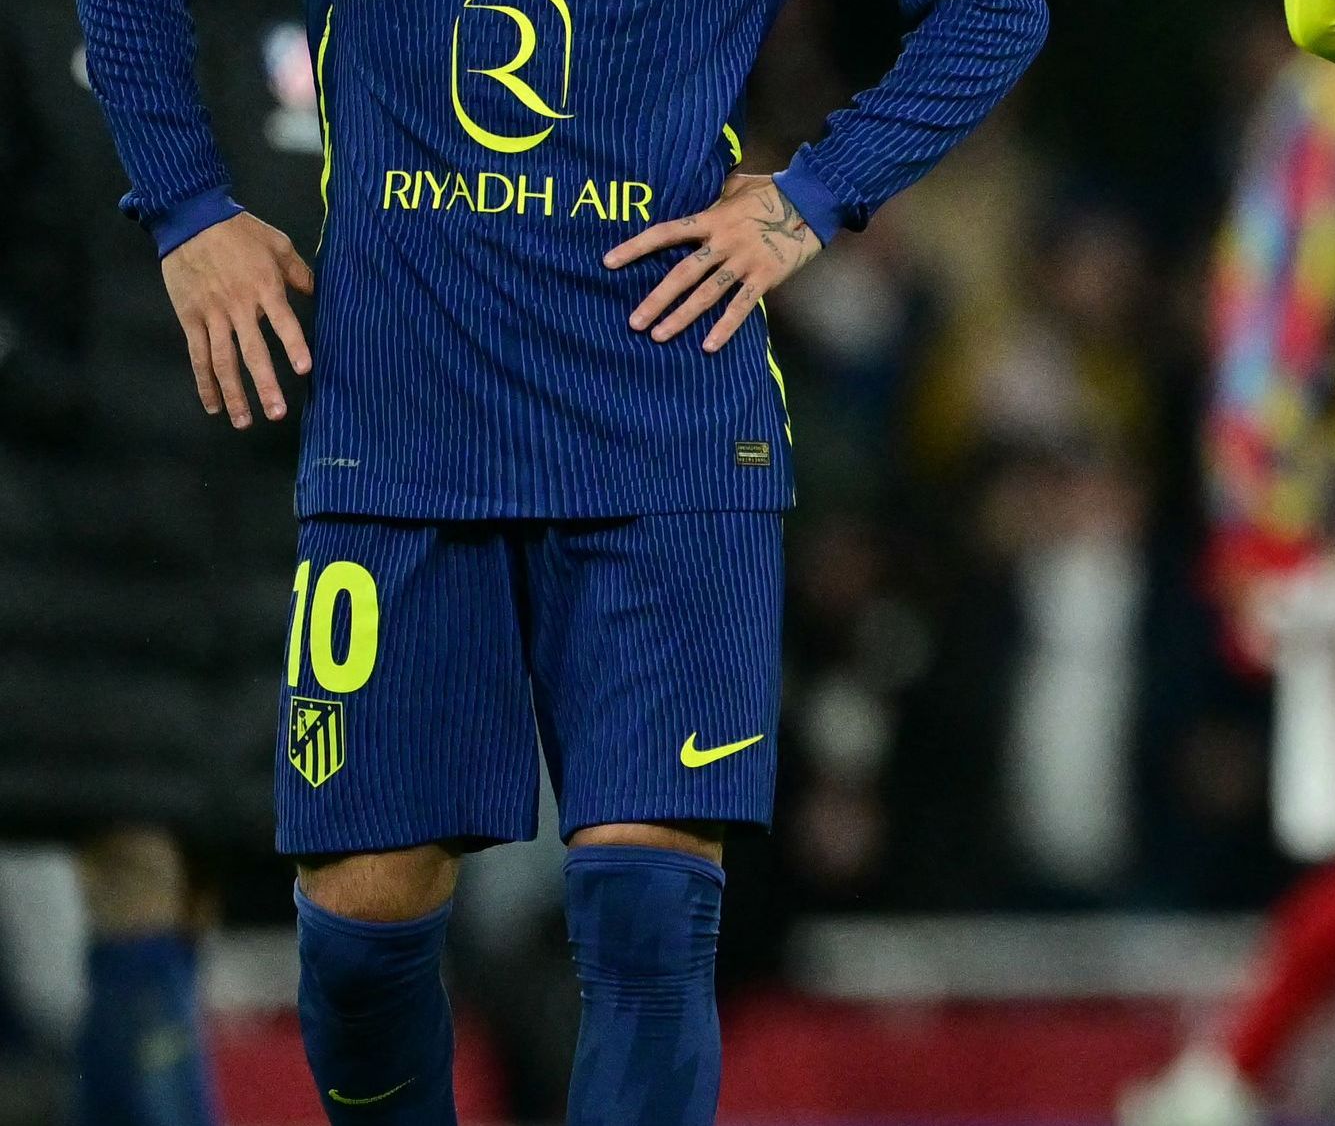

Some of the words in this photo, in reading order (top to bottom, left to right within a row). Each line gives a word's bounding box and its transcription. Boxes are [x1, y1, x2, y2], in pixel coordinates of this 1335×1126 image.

[383, 171, 554, 217] RIYADH
[570, 179, 653, 222] AIR
[287, 560, 380, 694] 10
